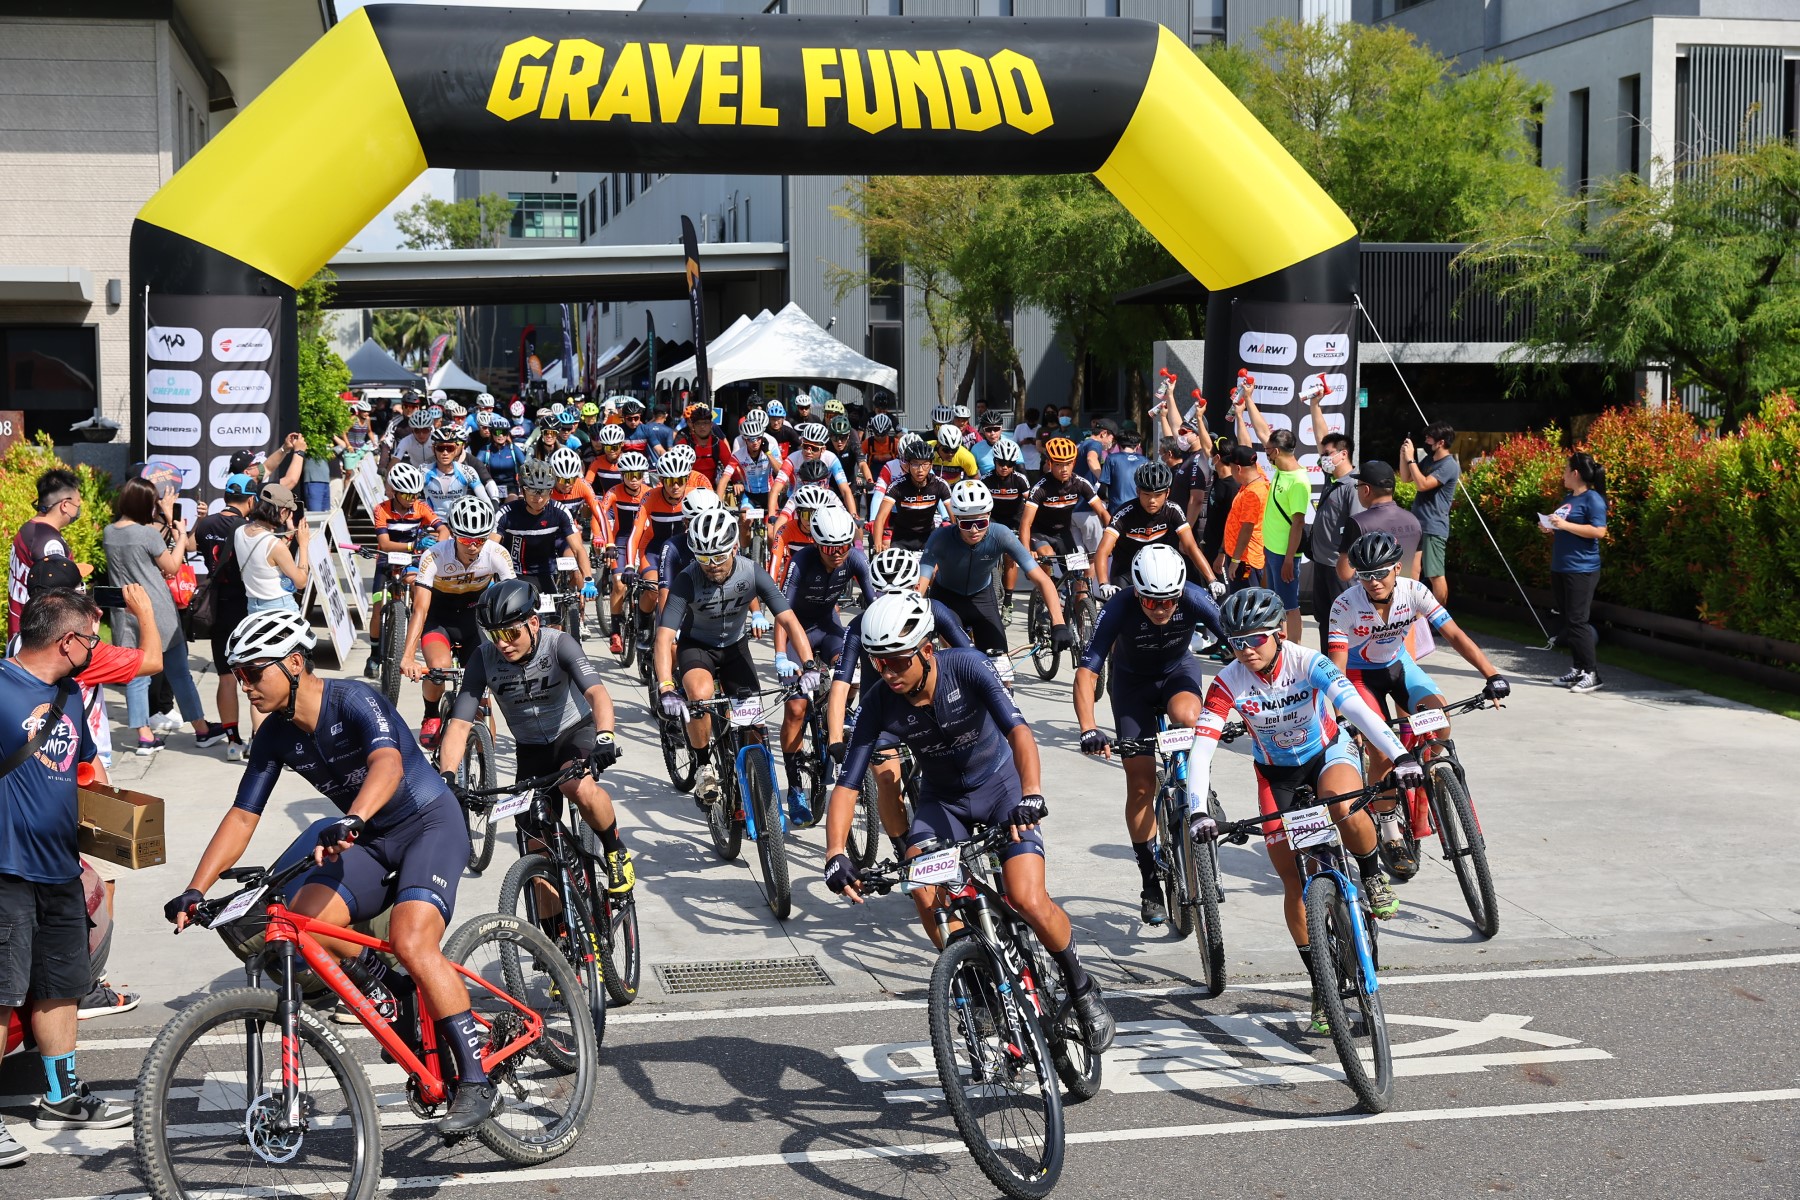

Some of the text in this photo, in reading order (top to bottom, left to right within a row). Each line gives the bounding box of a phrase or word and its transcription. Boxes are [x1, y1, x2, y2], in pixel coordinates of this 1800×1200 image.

[486, 35, 1054, 135] GRAVEL FUNDO
[1247, 344, 1286, 354] MARWI
[152, 387, 192, 396] CHEPARK
[0, 420, 12, 436] 8
[217, 426, 262, 435] GARMIN
[904, 494, 936, 502] xpedo
[1046, 493, 1078, 503] xpedo
[1130, 523, 1167, 535] xpedo
[698, 596, 750, 612] FTL
[1371, 616, 1418, 634] NANPAO
[497, 676, 561, 696] FTL
[1281, 679, 1296, 688] Liv
[1262, 690, 1309, 711] NANPAO
[21, 715, 80, 739] GRVEL
[1414, 715, 1443, 727] MB309
[40, 737, 77, 756] UNDO
[1163, 735, 1194, 745] MB404
[1291, 821, 1326, 837] MW01
[914, 859, 956, 877] MB302
[478, 919, 520, 935] GOODYEAR
[589, 932, 605, 983] MAXXIS
[1002, 992, 1022, 1033] FOX
[298, 1009, 346, 1056] OODYEAR
